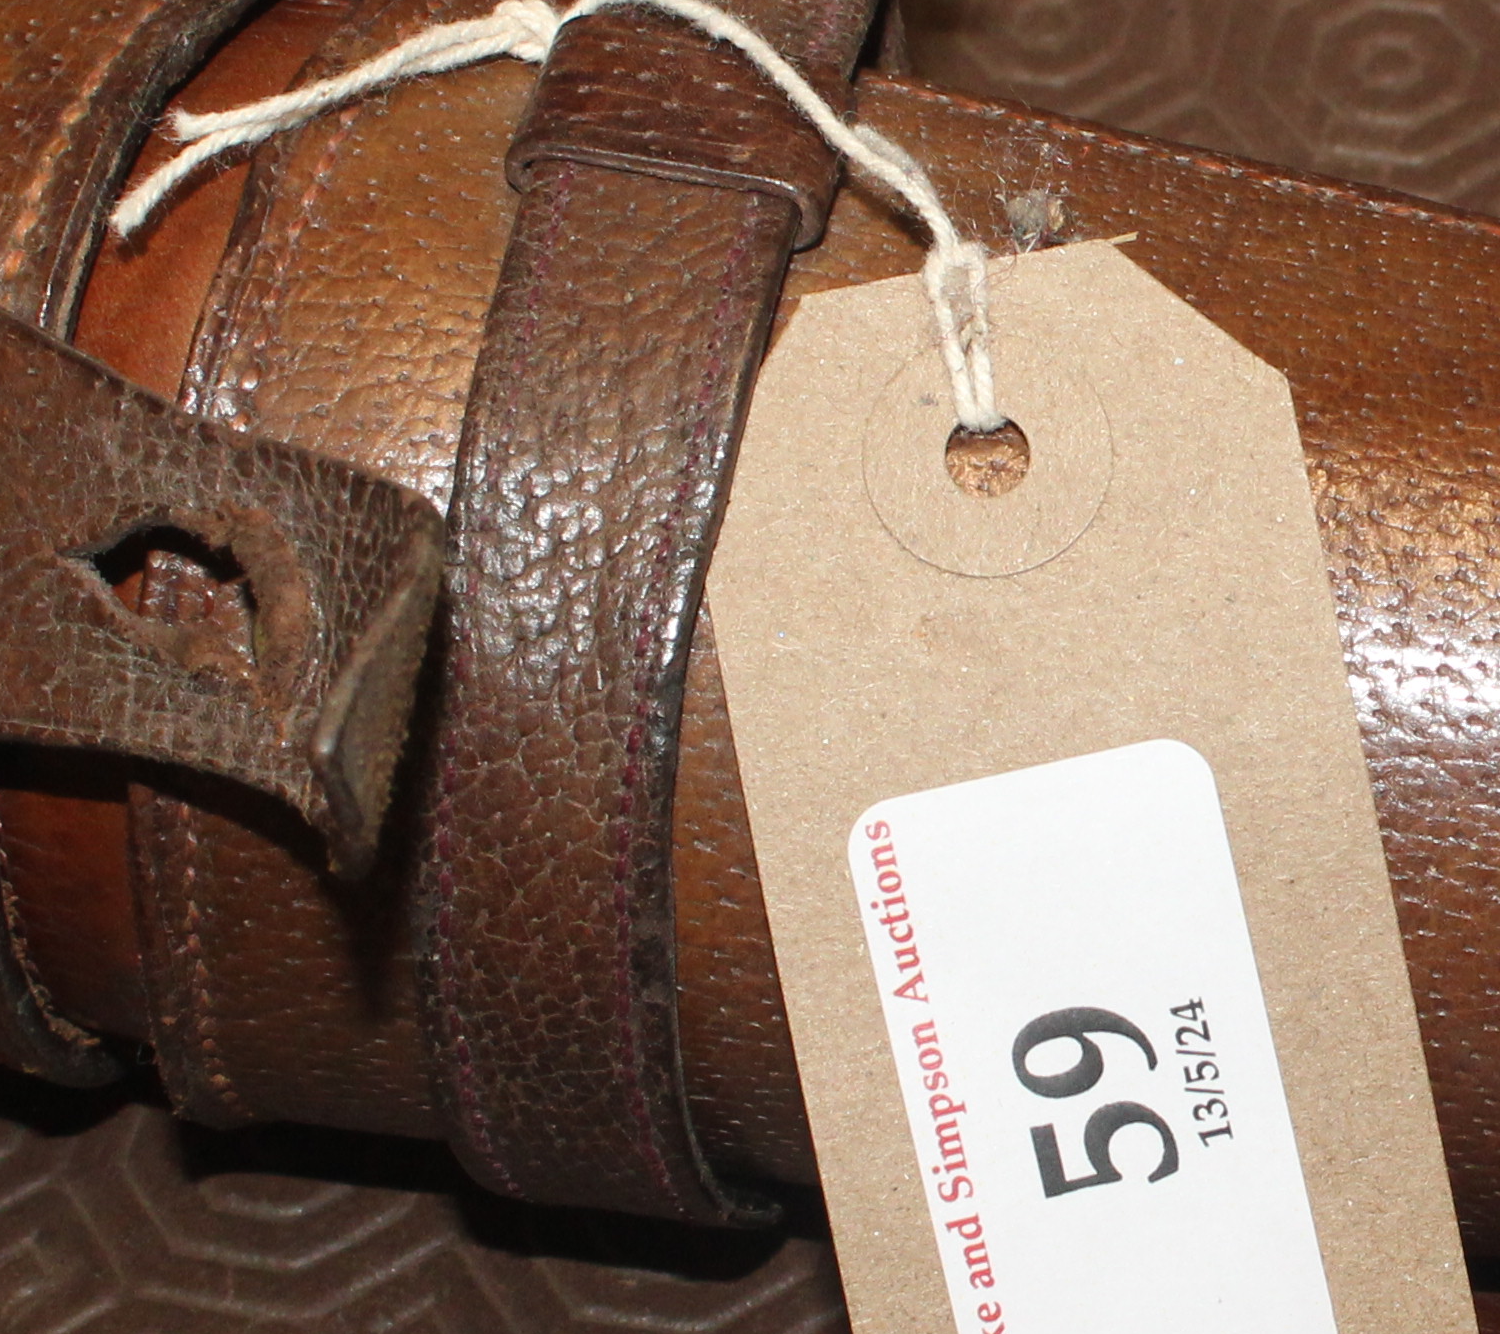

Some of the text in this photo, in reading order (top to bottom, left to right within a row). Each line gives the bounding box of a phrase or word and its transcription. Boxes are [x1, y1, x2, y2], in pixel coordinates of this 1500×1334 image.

[866, 820, 929, 1004] Auctions
[913, 1020, 976, 1203] Simpson
[1012, 1006, 1180, 1199] 59
[1170, 998, 1234, 1148] 13/5/24
[946, 1212, 996, 1288] and
